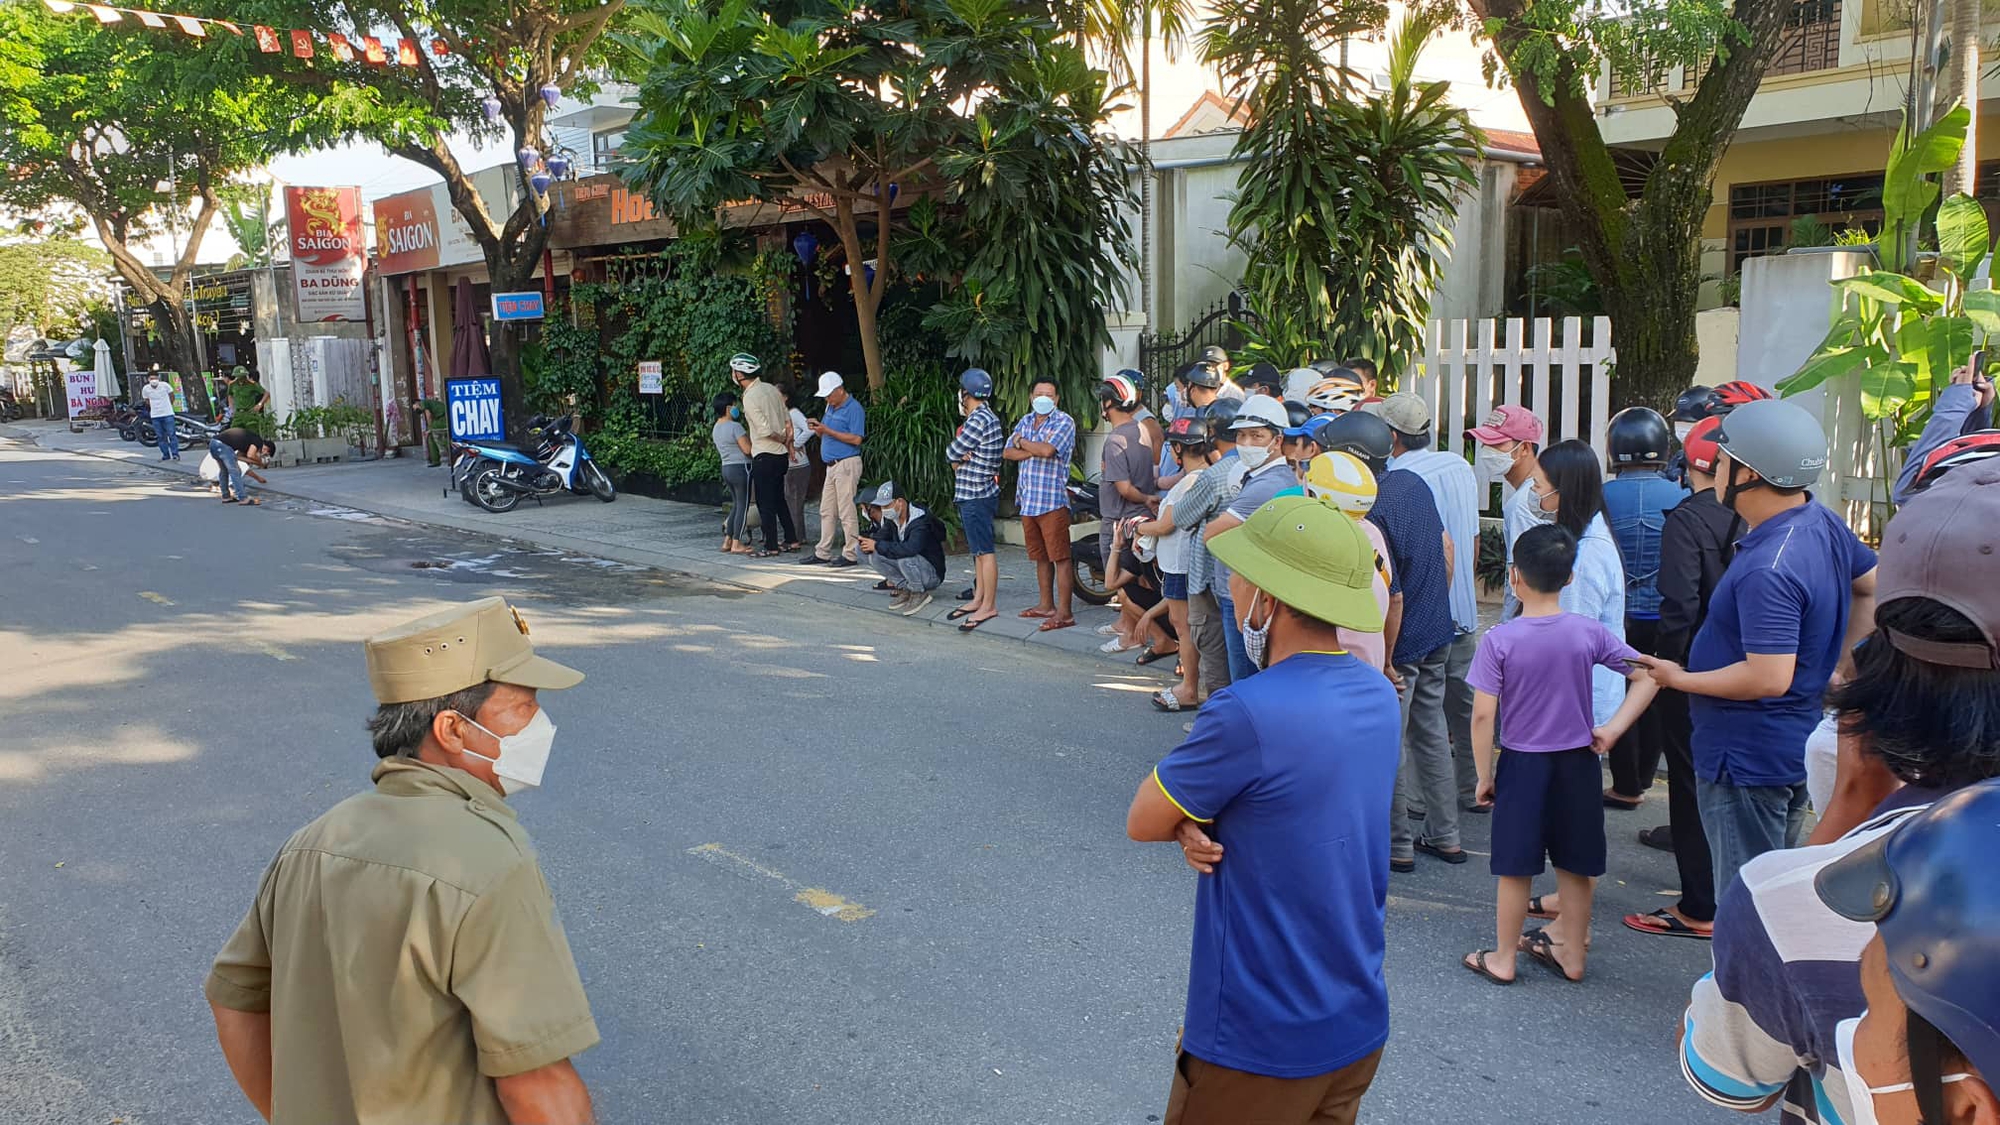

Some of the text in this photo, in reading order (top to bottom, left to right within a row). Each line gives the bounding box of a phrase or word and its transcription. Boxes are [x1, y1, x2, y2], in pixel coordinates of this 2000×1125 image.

[404, 210, 413, 221] BIA
[316, 229, 333, 238] BIA
[388, 220, 433, 254] SAIGON
[297, 237, 351, 250] SAIGON
[300, 275, 359, 288] BA DŨNG
[69, 373, 90, 383] BÚN
[80, 386, 95, 395] HU
[451, 380, 498, 399] TIỆM
[70, 396, 83, 408] BÀ
[451, 398, 500, 437] CHAY
